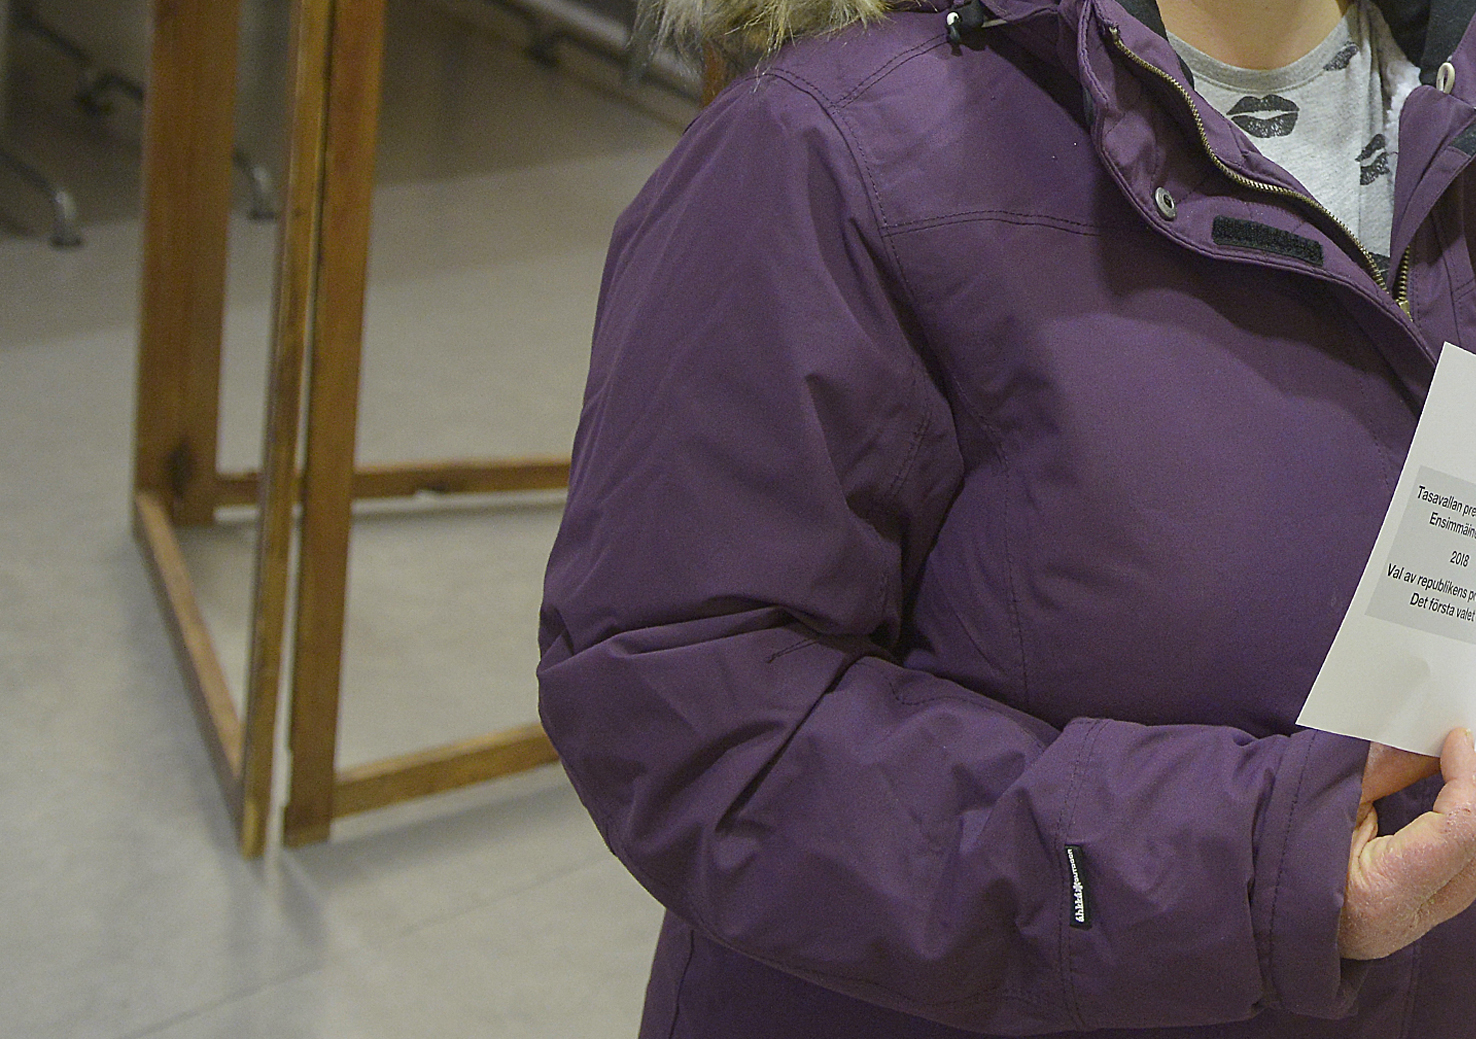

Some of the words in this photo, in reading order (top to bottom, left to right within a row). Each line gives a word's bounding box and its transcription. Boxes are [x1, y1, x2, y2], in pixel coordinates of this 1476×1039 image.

[1417, 485, 1463, 512] Tasavallan
[1449, 550, 1470, 568] 2018
[1387, 563, 1405, 580] Val
[1404, 571, 1417, 584] av
[1417, 575, 1468, 599] republikens
[1409, 592, 1428, 610] Det
[1428, 597, 1455, 617] första
[1456, 606, 1476, 622] valet
